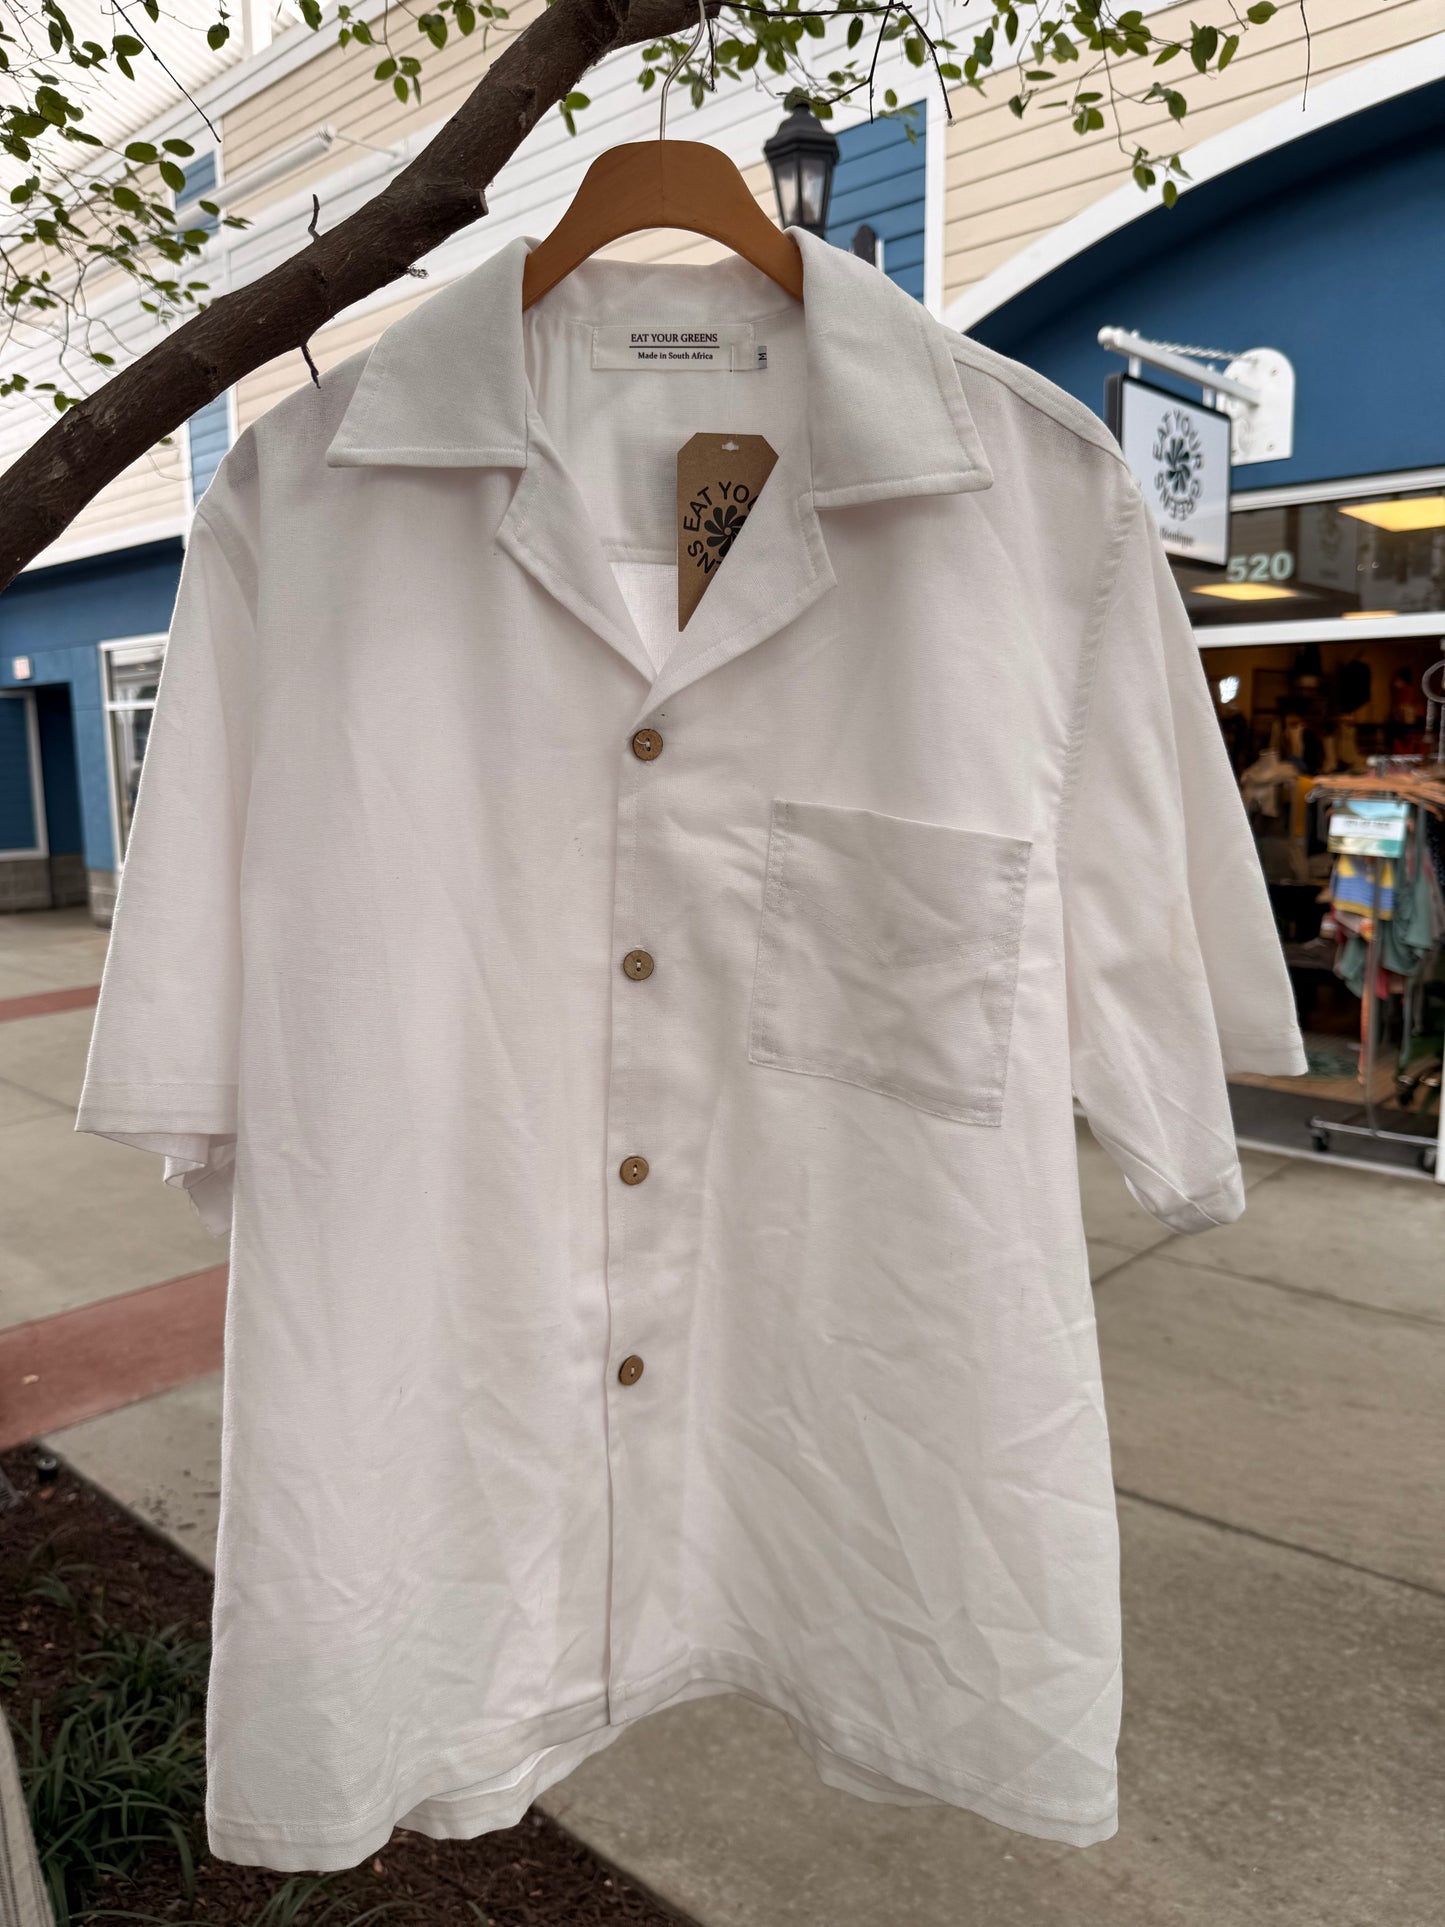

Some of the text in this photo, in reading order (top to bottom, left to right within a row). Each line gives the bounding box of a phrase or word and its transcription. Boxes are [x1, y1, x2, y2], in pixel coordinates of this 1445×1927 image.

[631, 333, 718, 342] EAT YOUR GREENS
[638, 352, 713, 360] Made in South Africa
[758, 352, 767, 361] M
[1153, 411, 1171, 462] EAT
[1173, 409, 1204, 470] YOUR
[683, 481, 759, 532] EAT YO
[1226, 551, 1294, 582] 520
